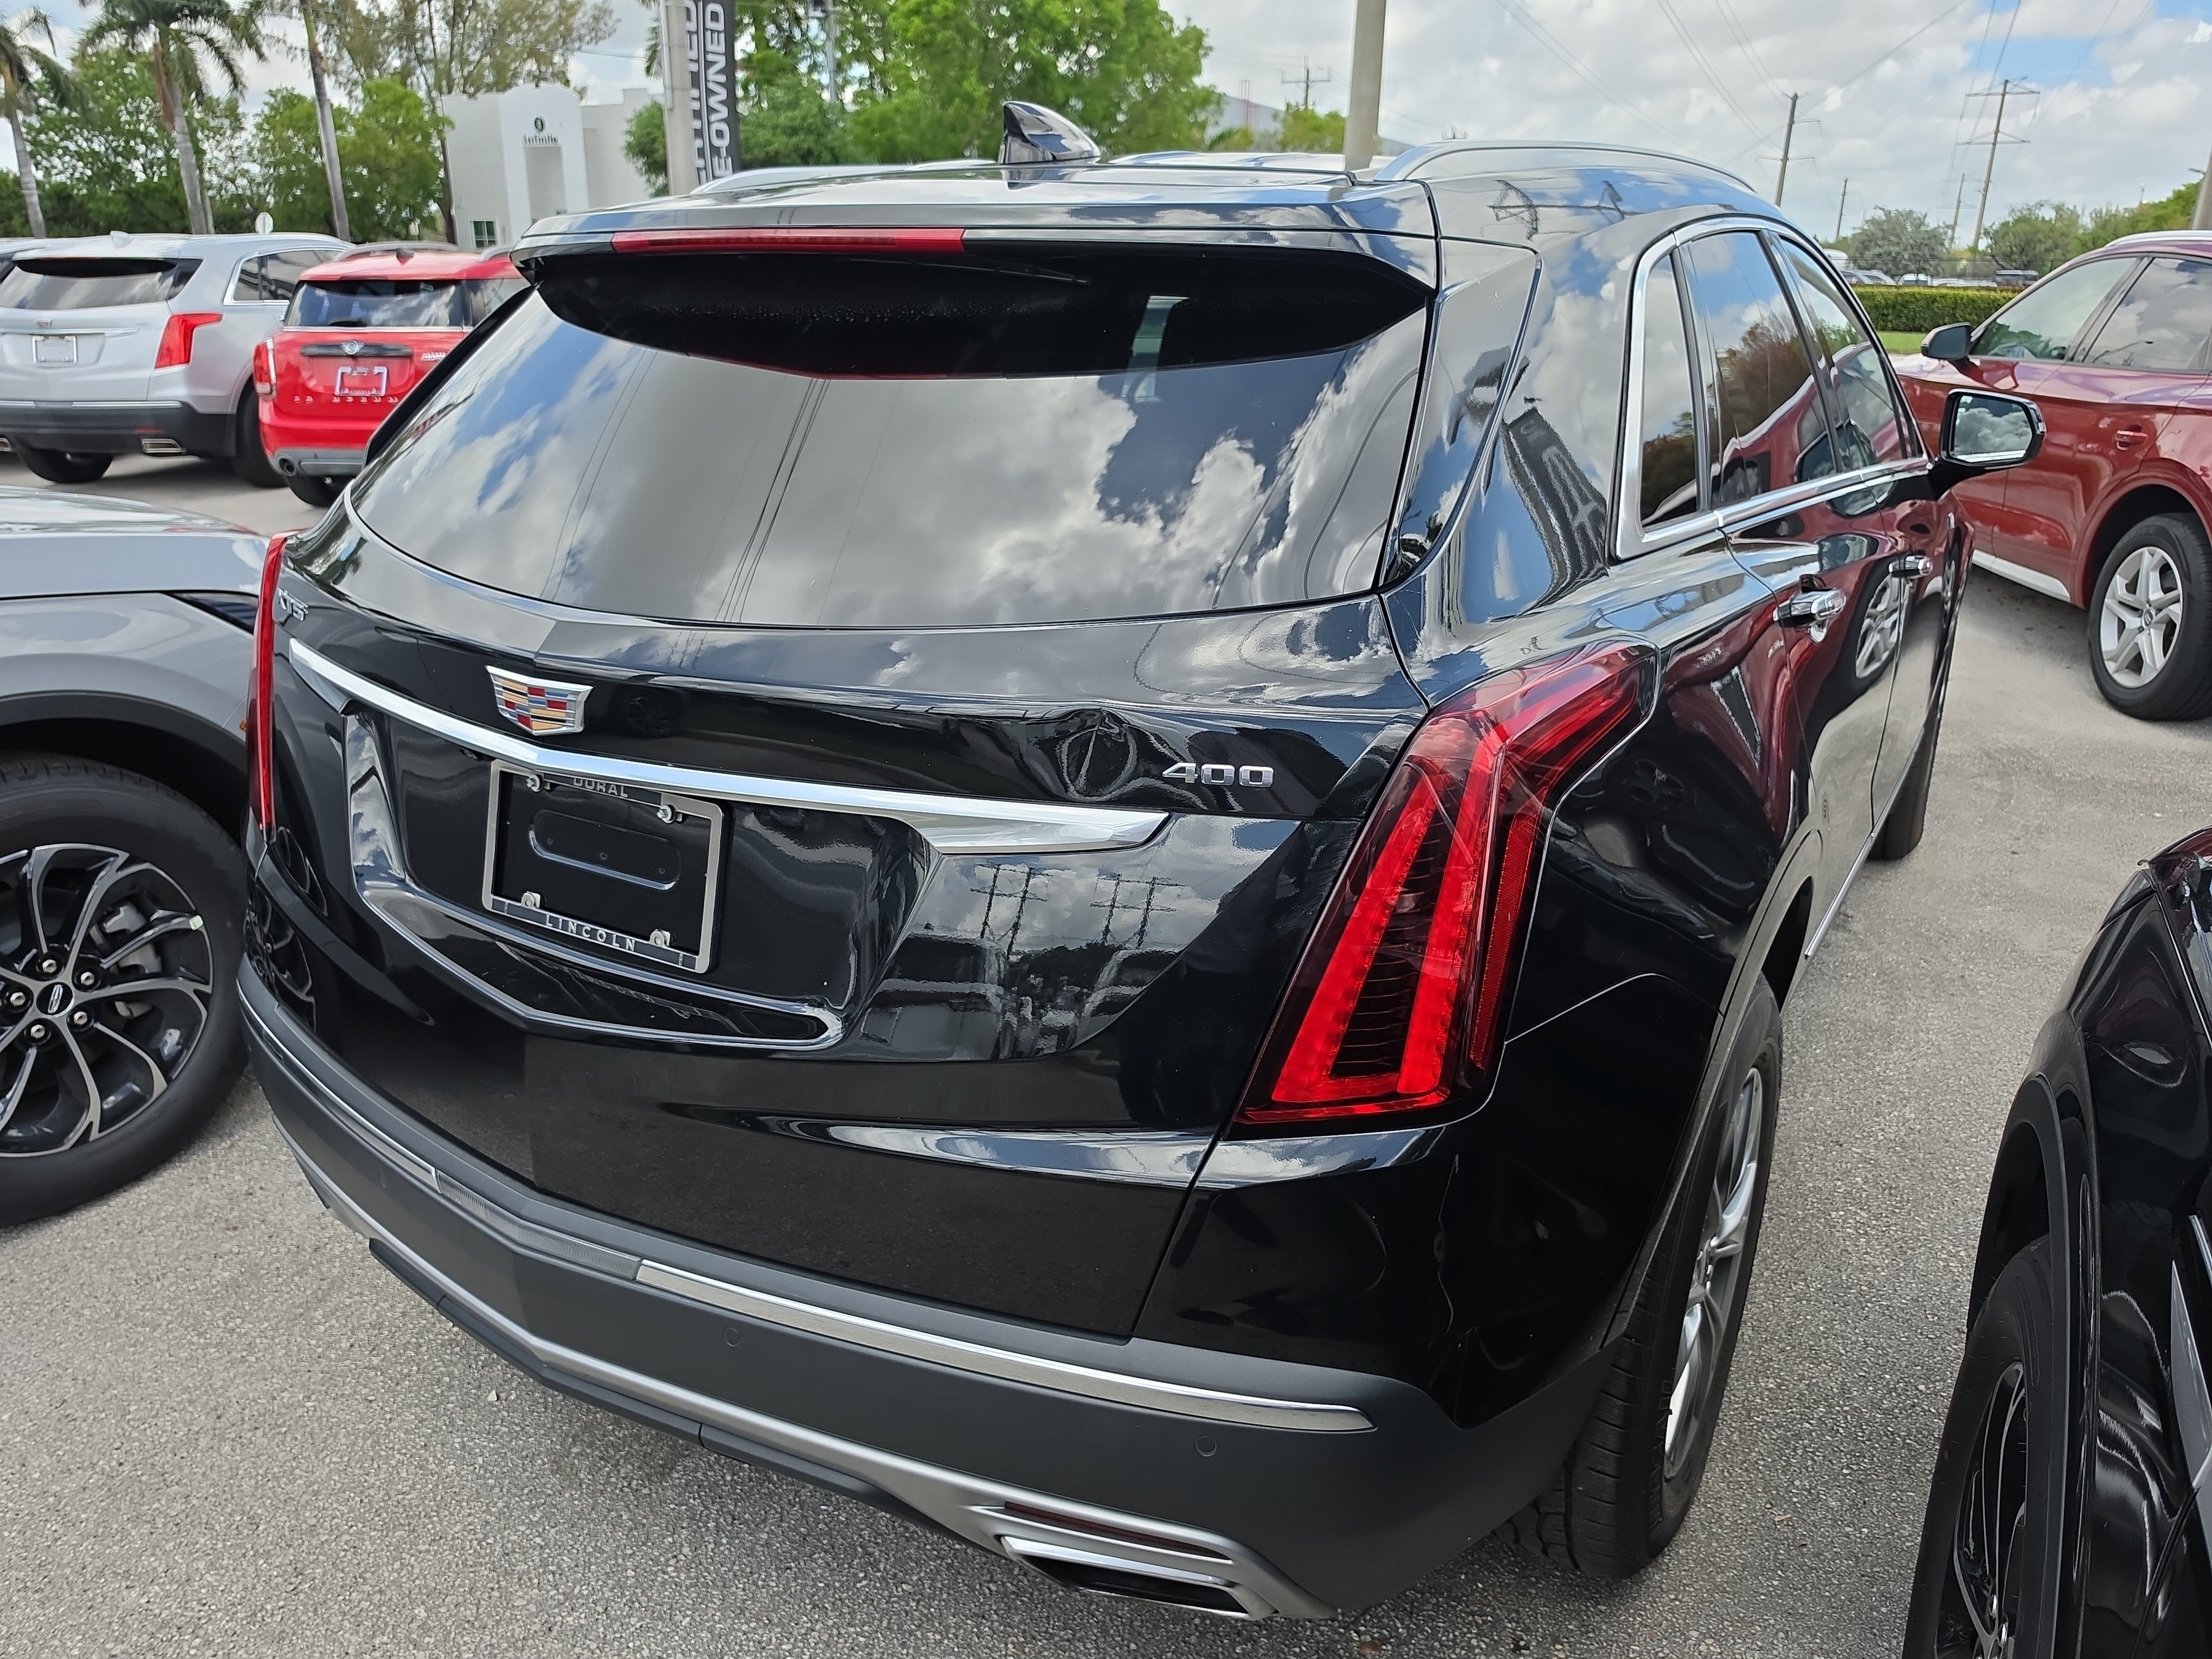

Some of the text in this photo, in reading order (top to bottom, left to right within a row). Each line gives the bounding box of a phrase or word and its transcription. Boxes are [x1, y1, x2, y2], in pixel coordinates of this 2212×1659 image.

[1162, 762, 1274, 787] 400
[574, 777, 628, 798] DORAL
[546, 915, 635, 951] LINCOLN
